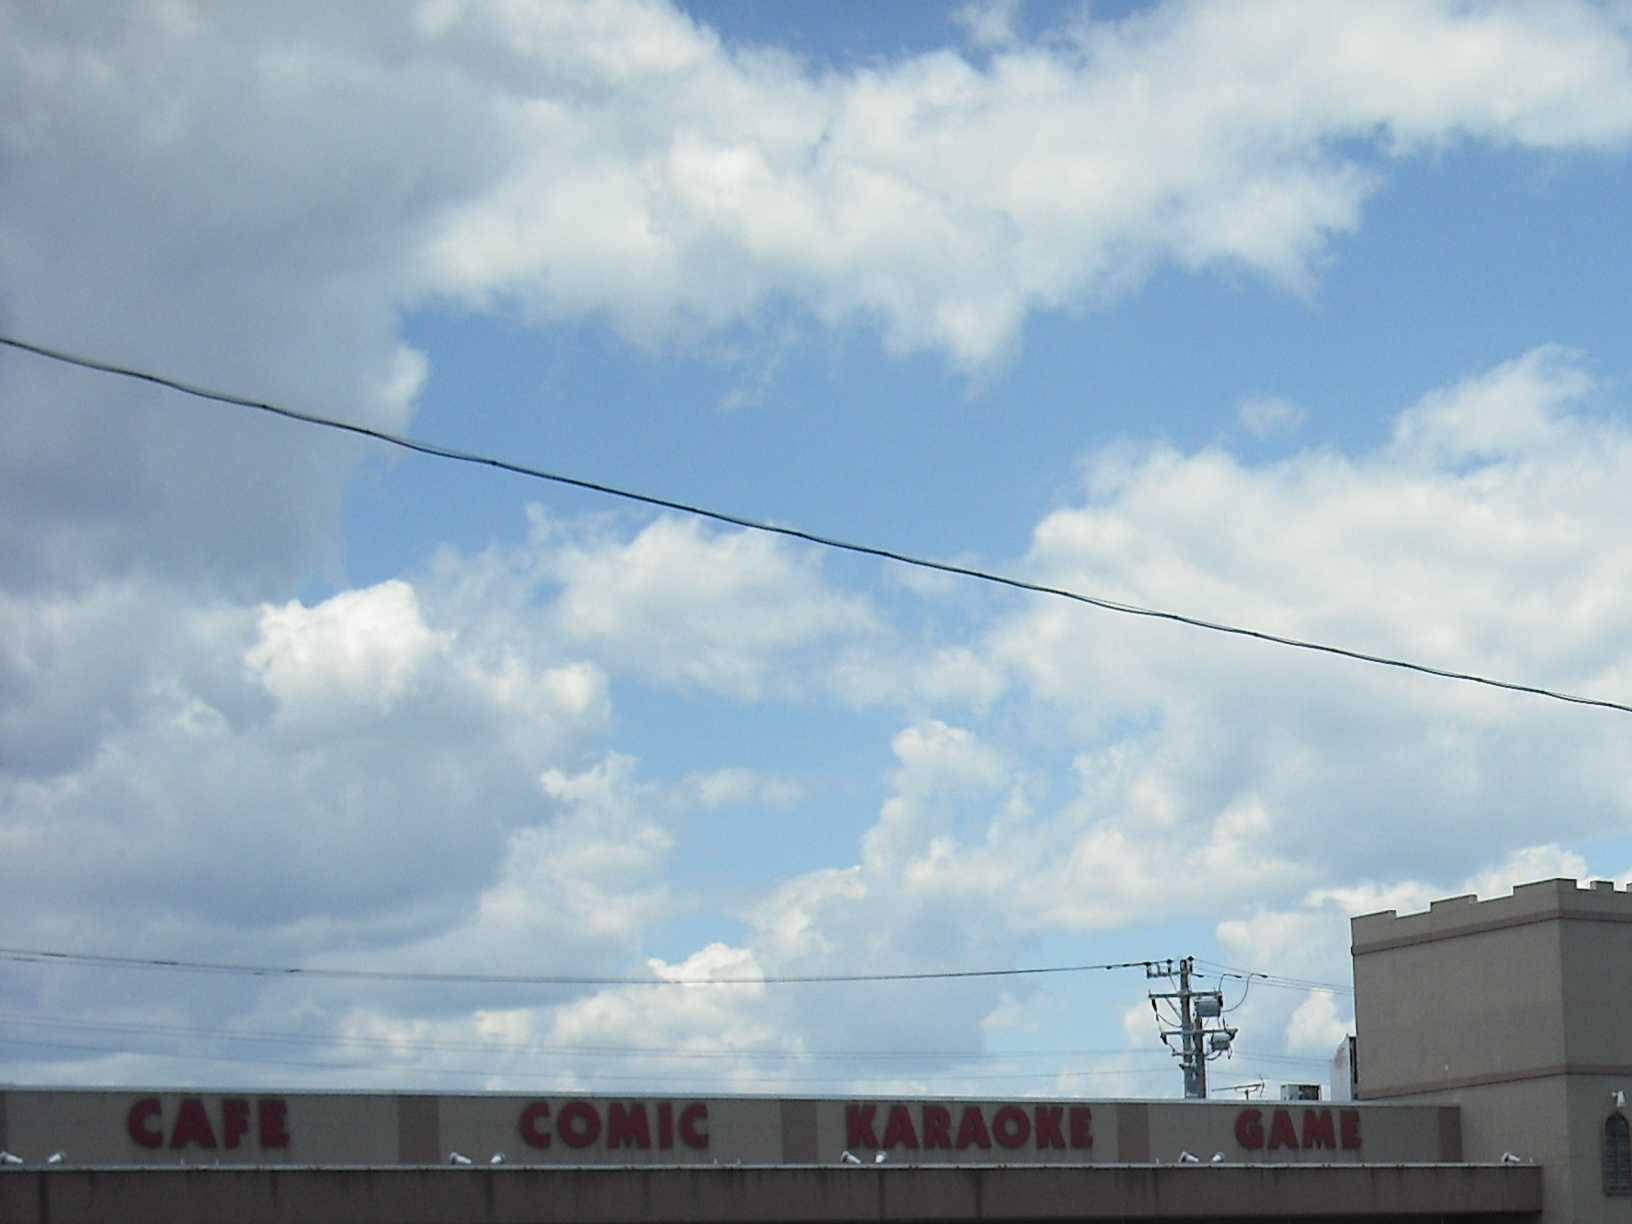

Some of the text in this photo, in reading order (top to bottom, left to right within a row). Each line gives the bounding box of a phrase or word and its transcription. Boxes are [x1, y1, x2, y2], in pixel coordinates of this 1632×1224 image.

[128, 1098, 290, 1149] CAFE
[519, 1101, 710, 1149] COMIC
[845, 1104, 1094, 1149] KARAOKE
[1235, 1108, 1362, 1149] GAME
